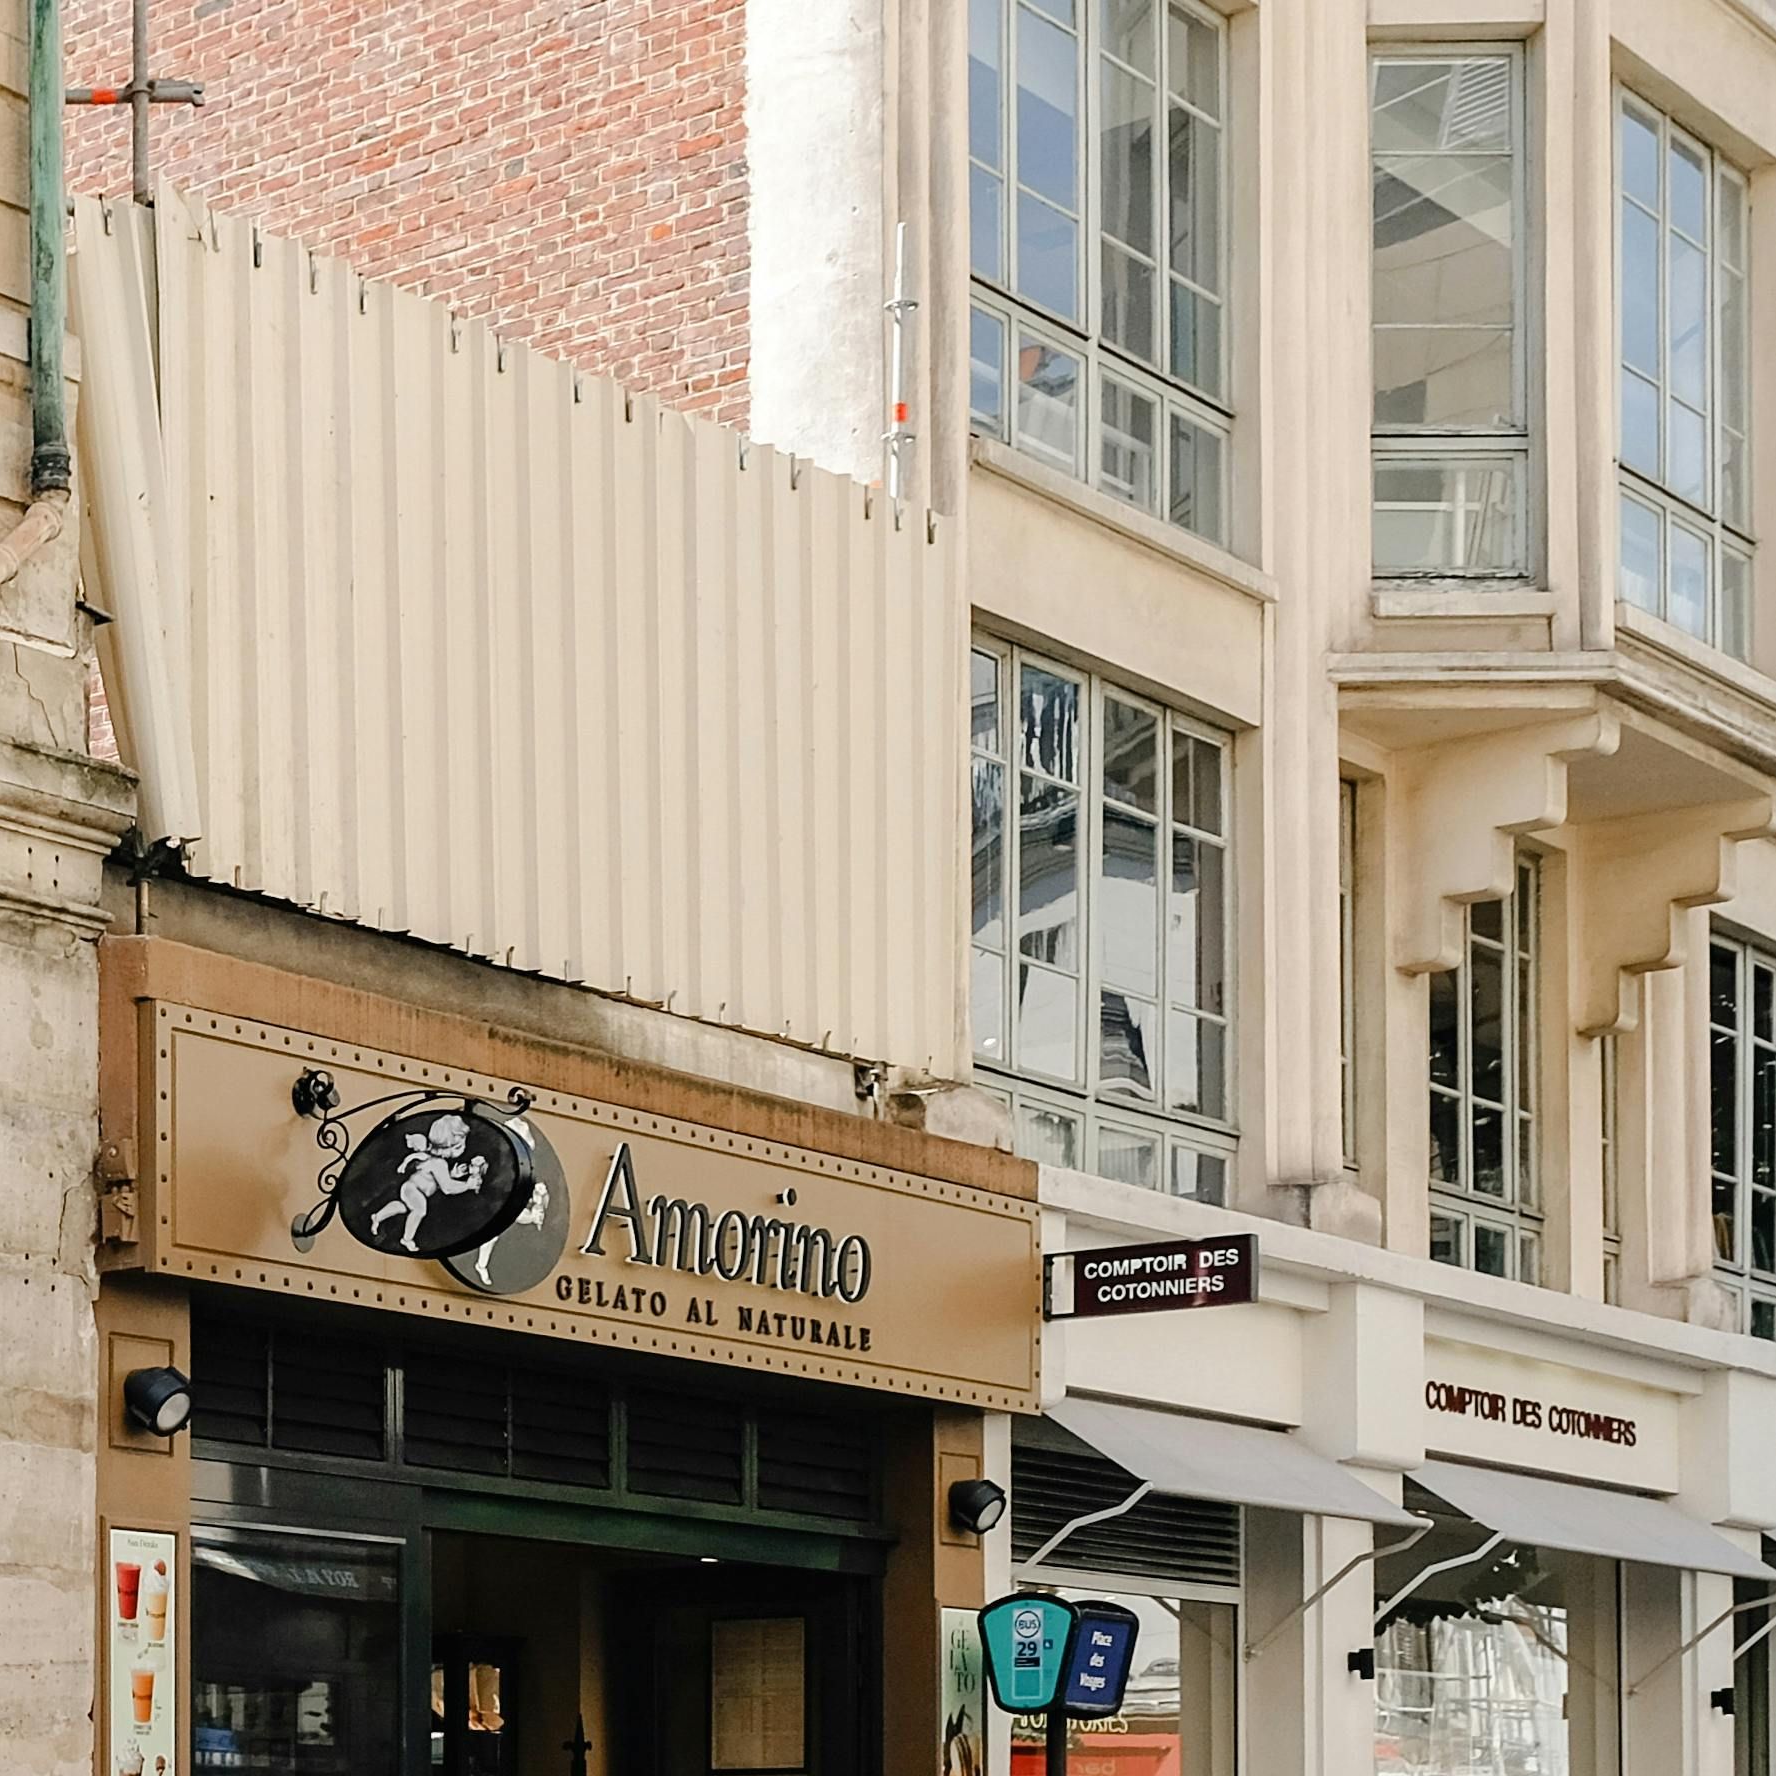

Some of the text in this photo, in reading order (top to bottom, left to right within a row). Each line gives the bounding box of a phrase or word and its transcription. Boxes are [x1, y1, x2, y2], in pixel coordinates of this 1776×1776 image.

[578, 1142, 872, 1304] Amorino
[1084, 1248, 1239, 1280] COMPTOIR DES
[1097, 1274, 1225, 1302] COTONNIERS
[555, 1274, 872, 1352] GELATO AL NATURALE
[1425, 1380, 1637, 1447] COMPTOIR DES COTONNIERS
[1018, 1619, 1038, 1630] BUS
[1017, 1641, 1038, 1656] 29
[1091, 1631, 1113, 1647] Place
[1089, 1652, 1105, 1668] des
[1080, 1672, 1106, 1692] Vosges
